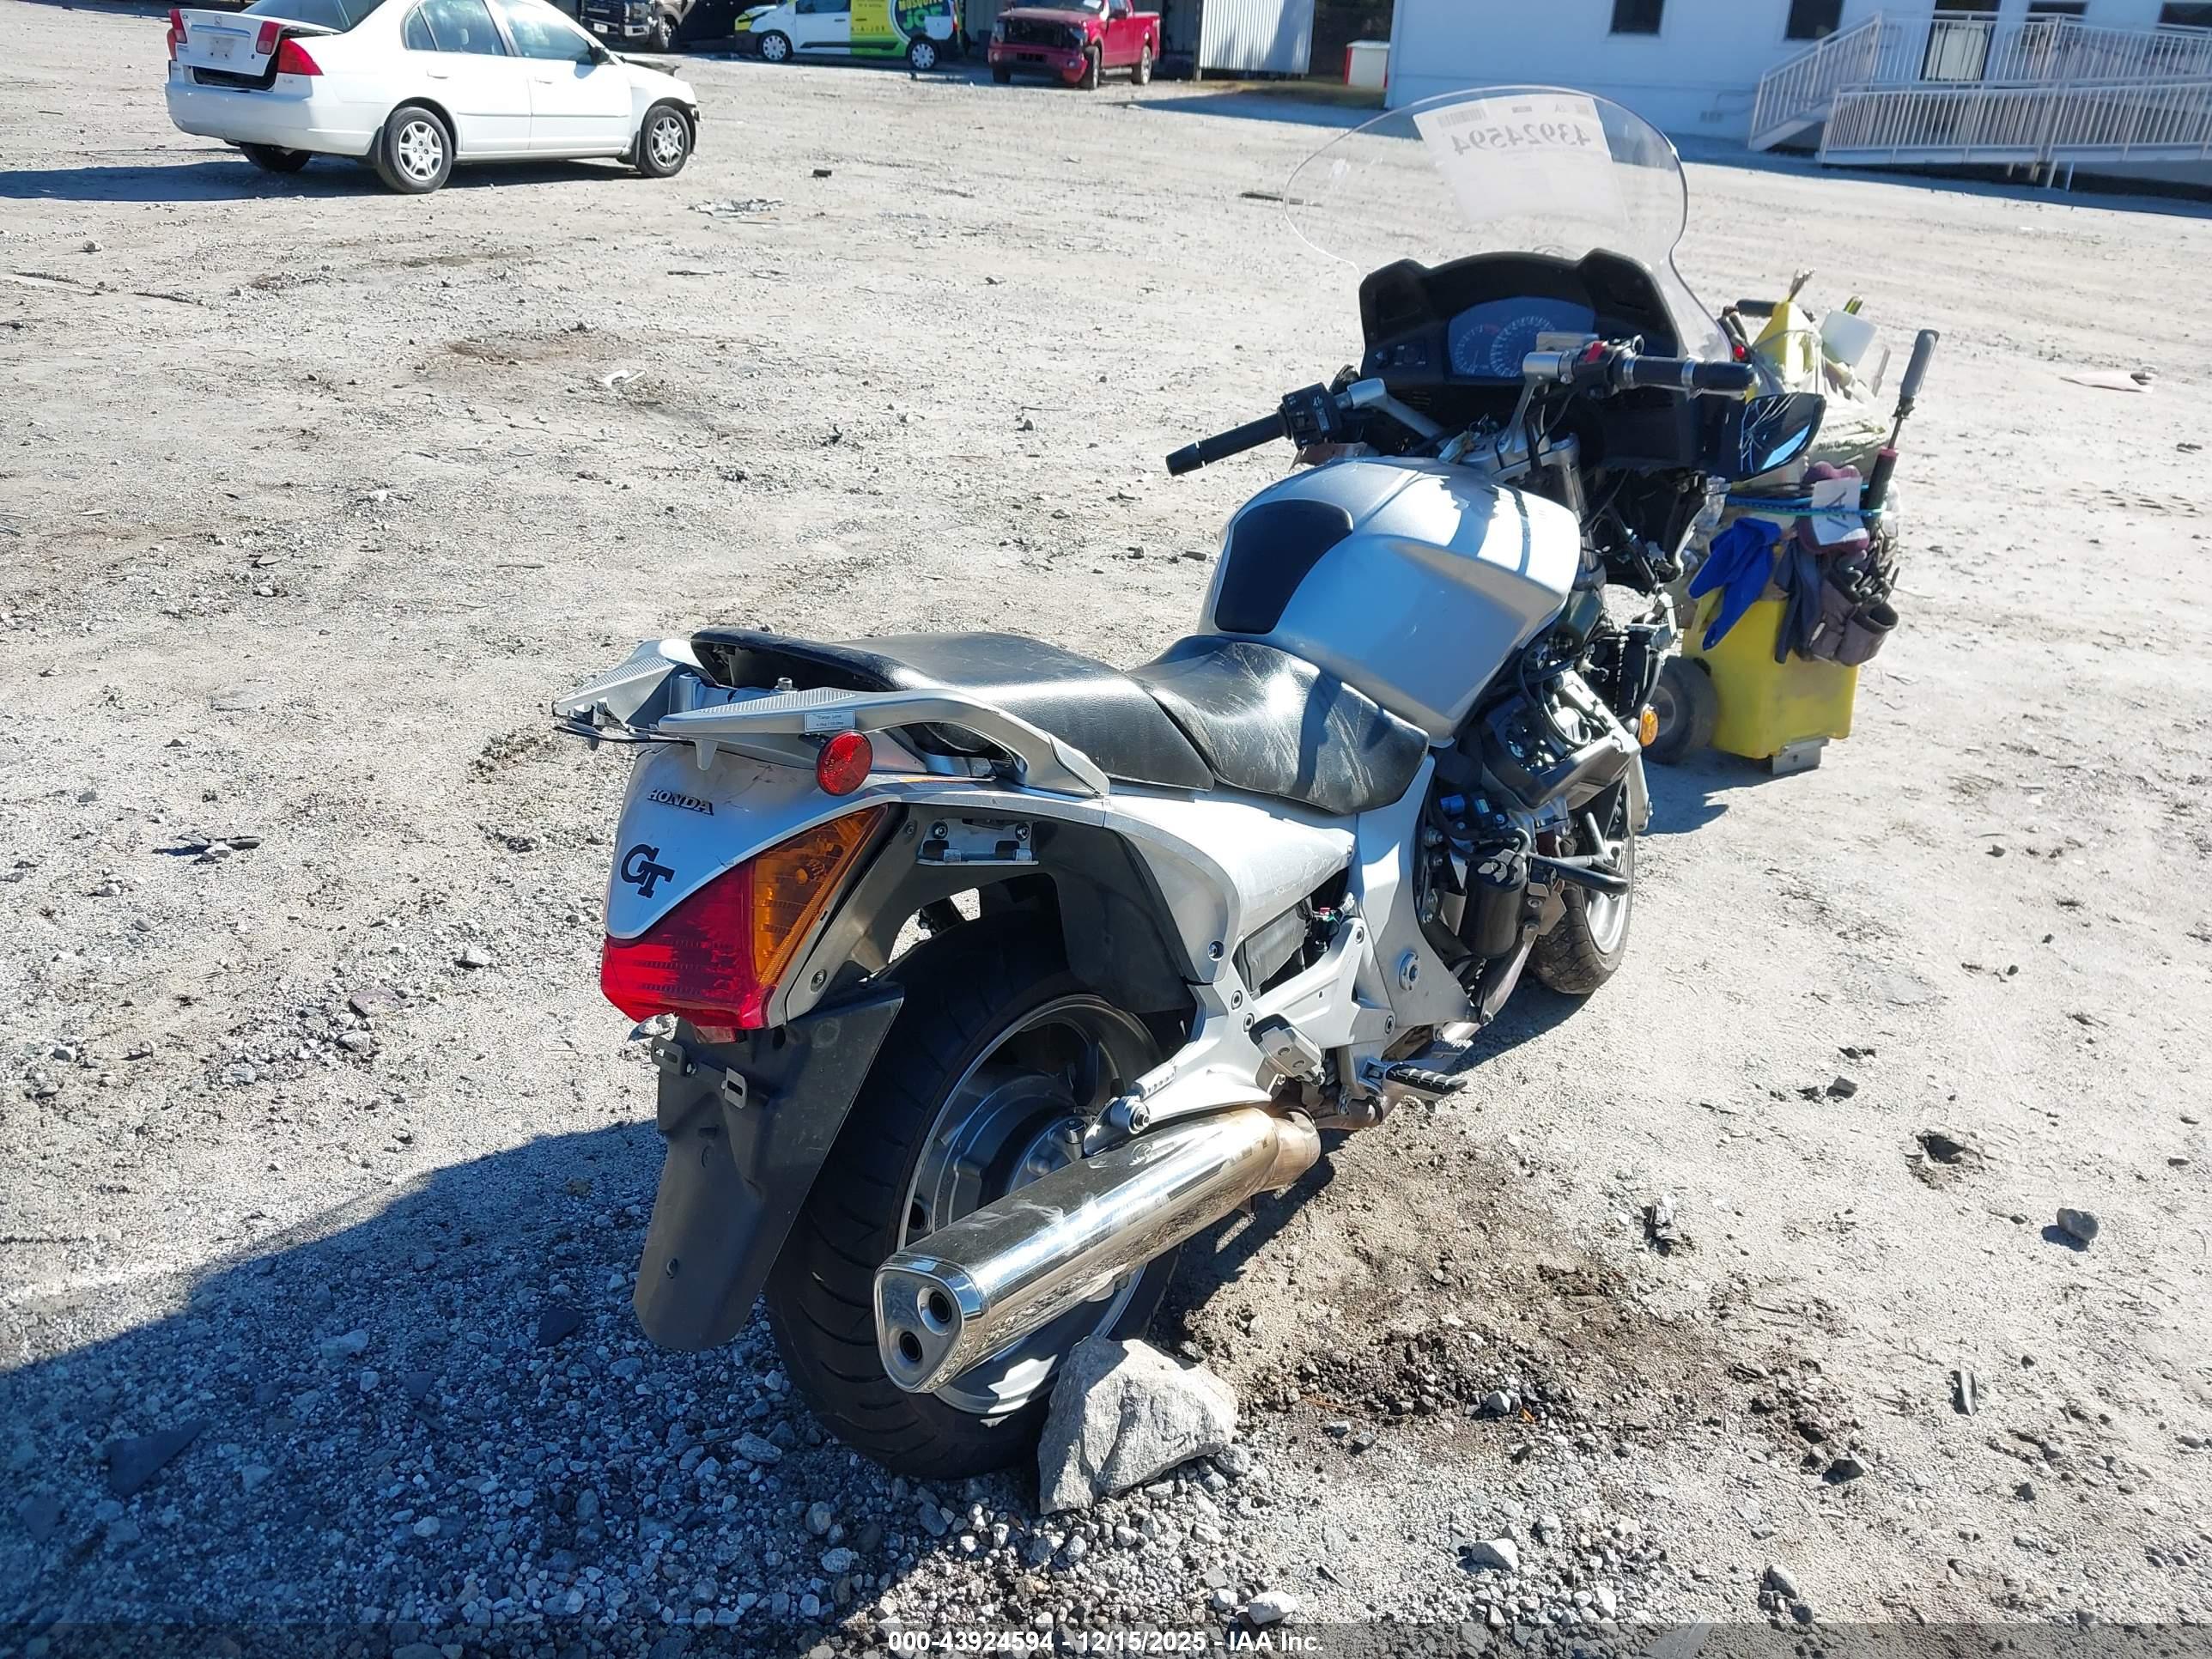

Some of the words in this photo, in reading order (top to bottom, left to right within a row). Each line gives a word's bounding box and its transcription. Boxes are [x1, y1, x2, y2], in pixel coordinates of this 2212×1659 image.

[898, 0, 943, 11] MOSQU
[647, 789, 714, 816] HONDA
[621, 843, 675, 898] GT
